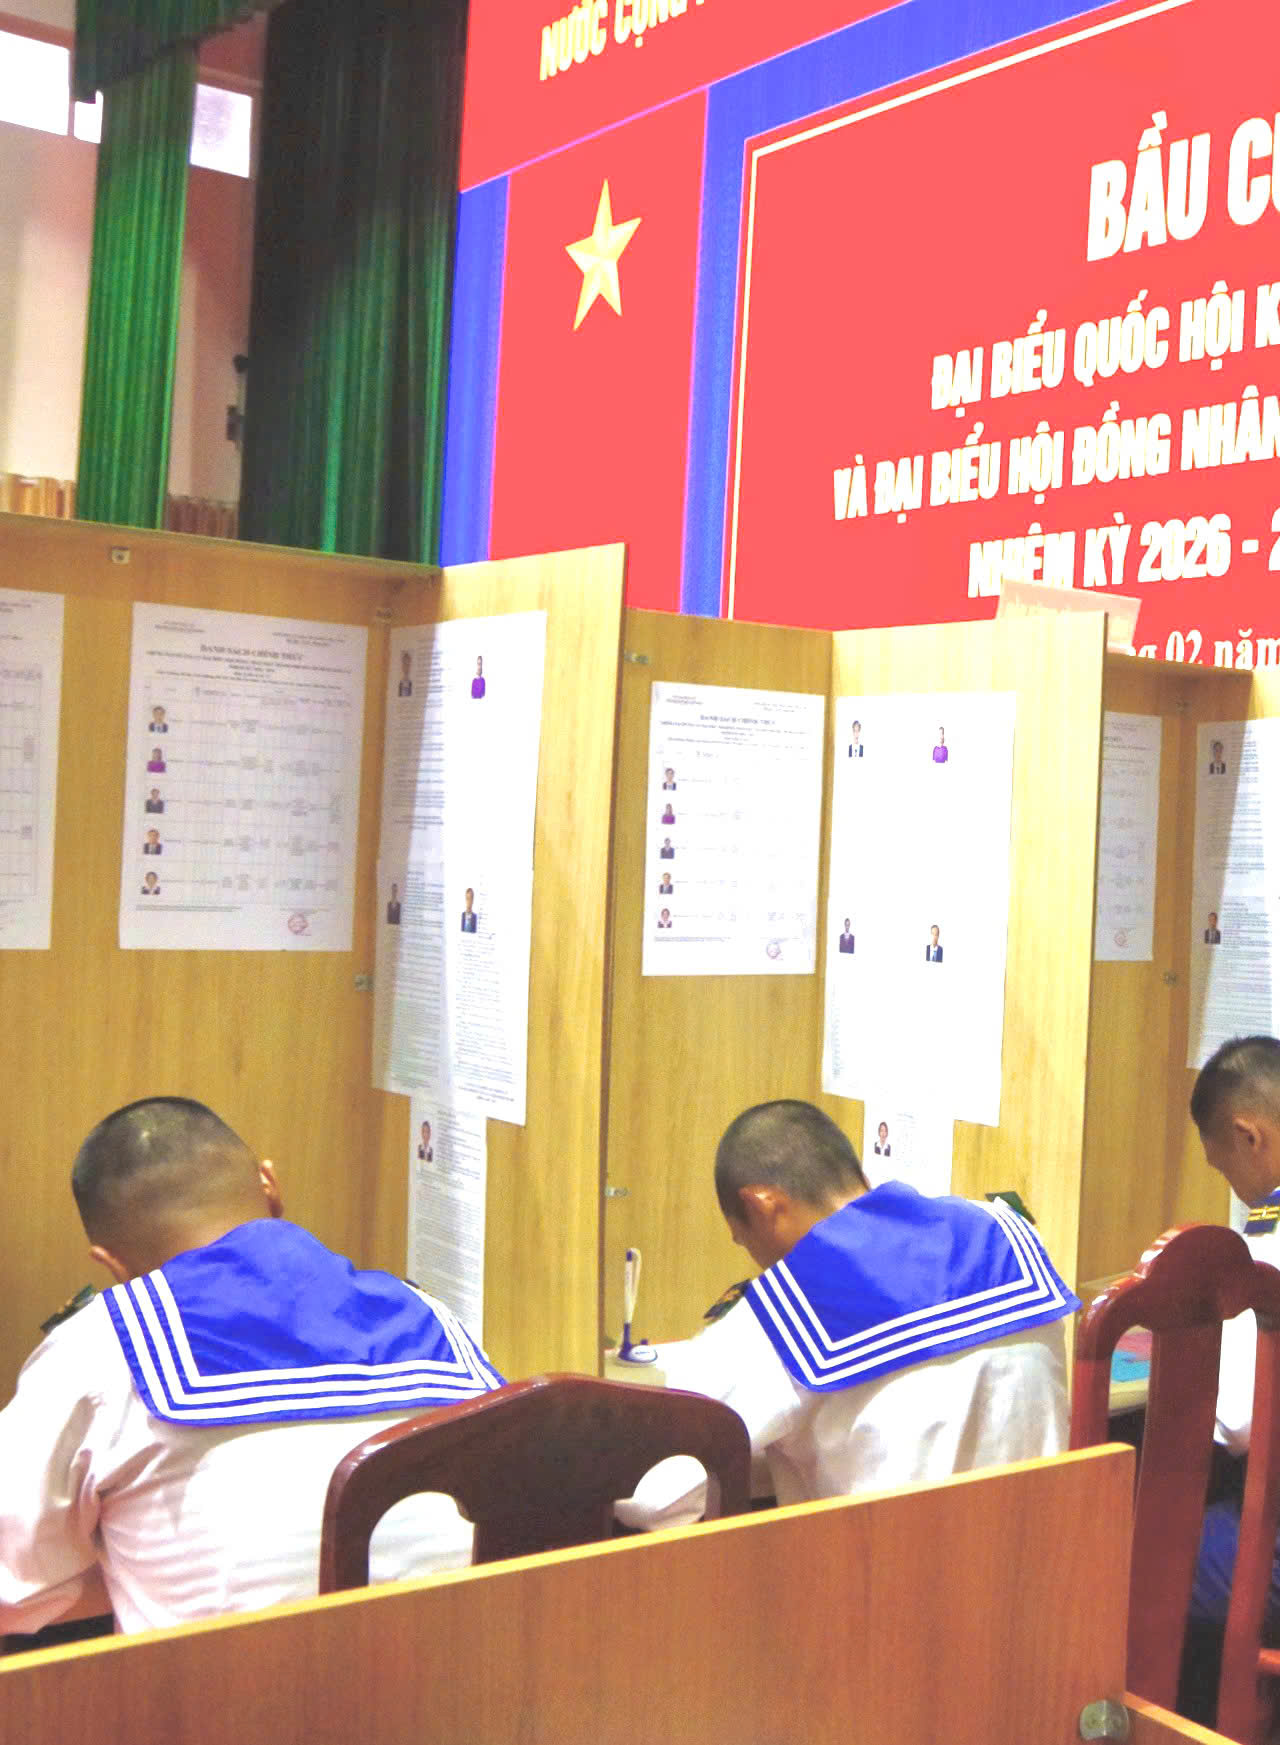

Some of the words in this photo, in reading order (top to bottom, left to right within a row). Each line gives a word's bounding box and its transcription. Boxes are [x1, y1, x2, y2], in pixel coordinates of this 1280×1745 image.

[614, 0, 687, 48] CỘ
[1087, 111, 1210, 261] BẦU
[931, 347, 984, 418] ĐẠI
[991, 309, 1066, 398] BIỂU
[1074, 289, 1169, 387] QUỐC
[1179, 280, 1245, 370] HỘI
[834, 454, 868, 520] VÀ
[874, 456, 923, 523] ĐẠI
[930, 422, 1001, 506] BIỂU
[1008, 421, 1064, 504] HỘI
[1072, 401, 1171, 485] ĐỒNG
[1080, 512, 1131, 588] KỲ
[1138, 514, 1231, 582] 2026
[1242, 540, 1259, 553] -
[1166, 630, 1202, 664] 02
